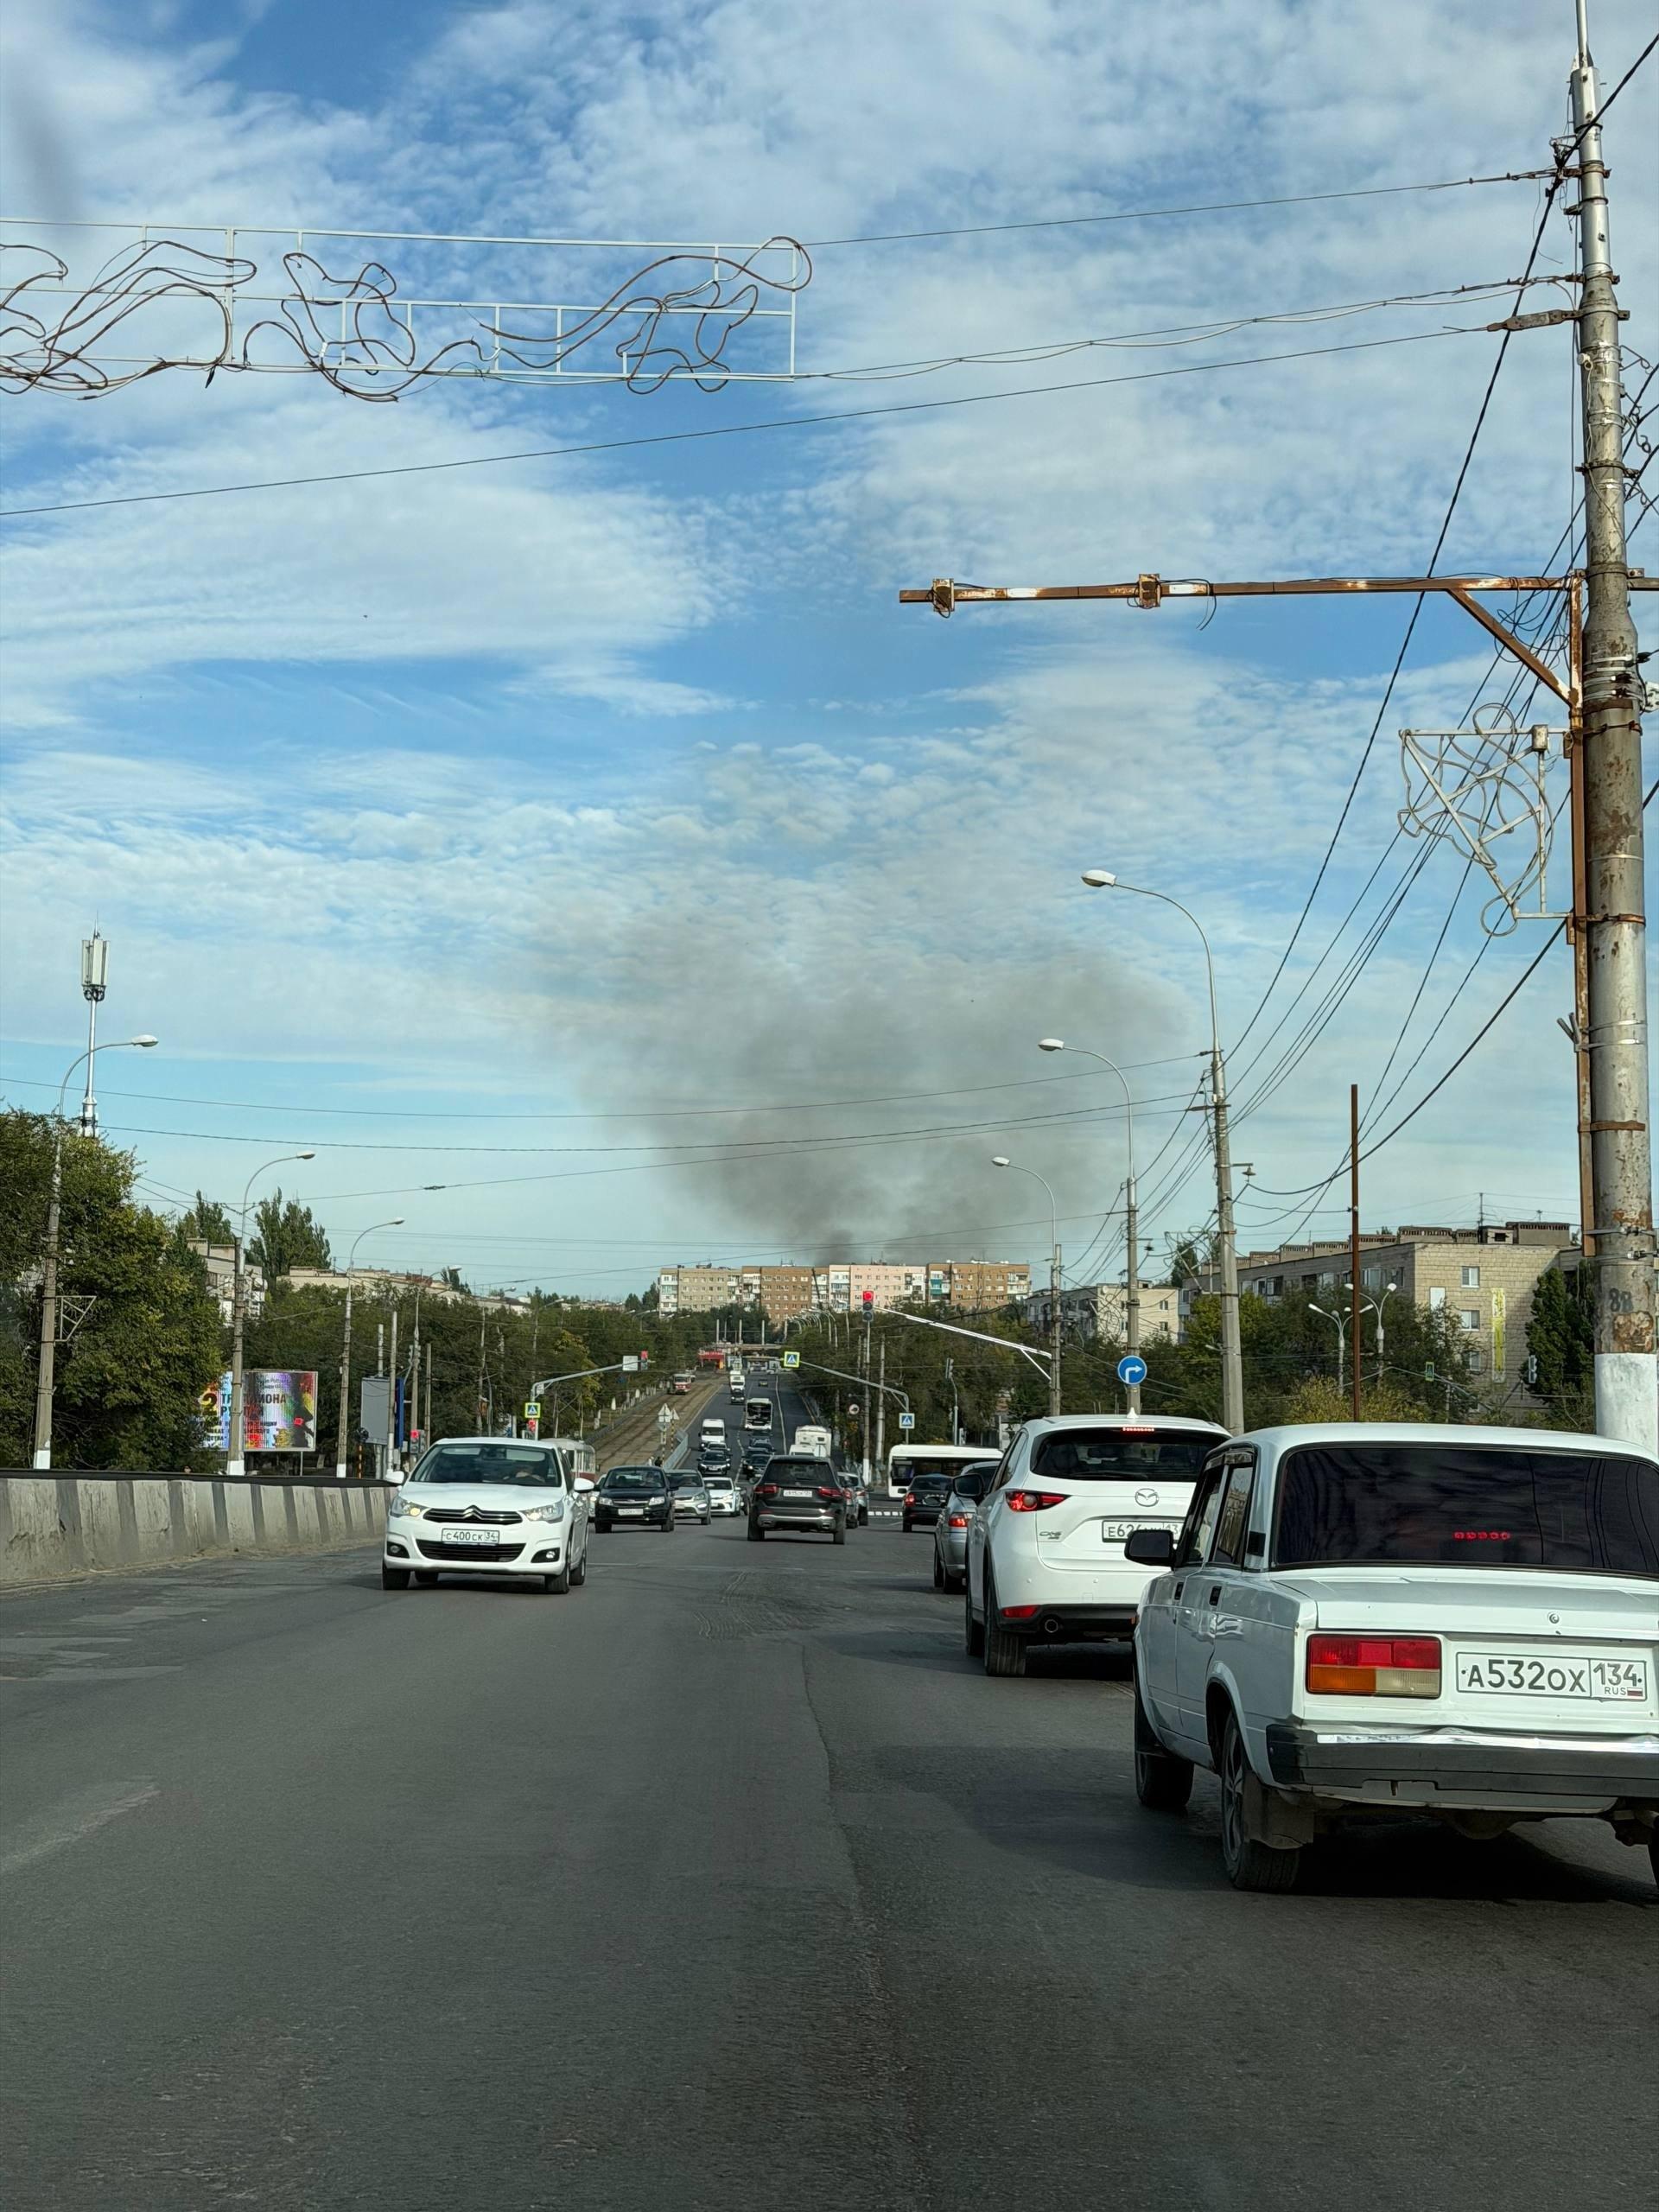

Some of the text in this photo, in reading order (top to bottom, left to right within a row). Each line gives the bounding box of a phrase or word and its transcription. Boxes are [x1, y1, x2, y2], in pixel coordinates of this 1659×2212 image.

[1467, 1659, 1637, 1693] А532ОХ 134
[1604, 1686, 1627, 1695] RUS
